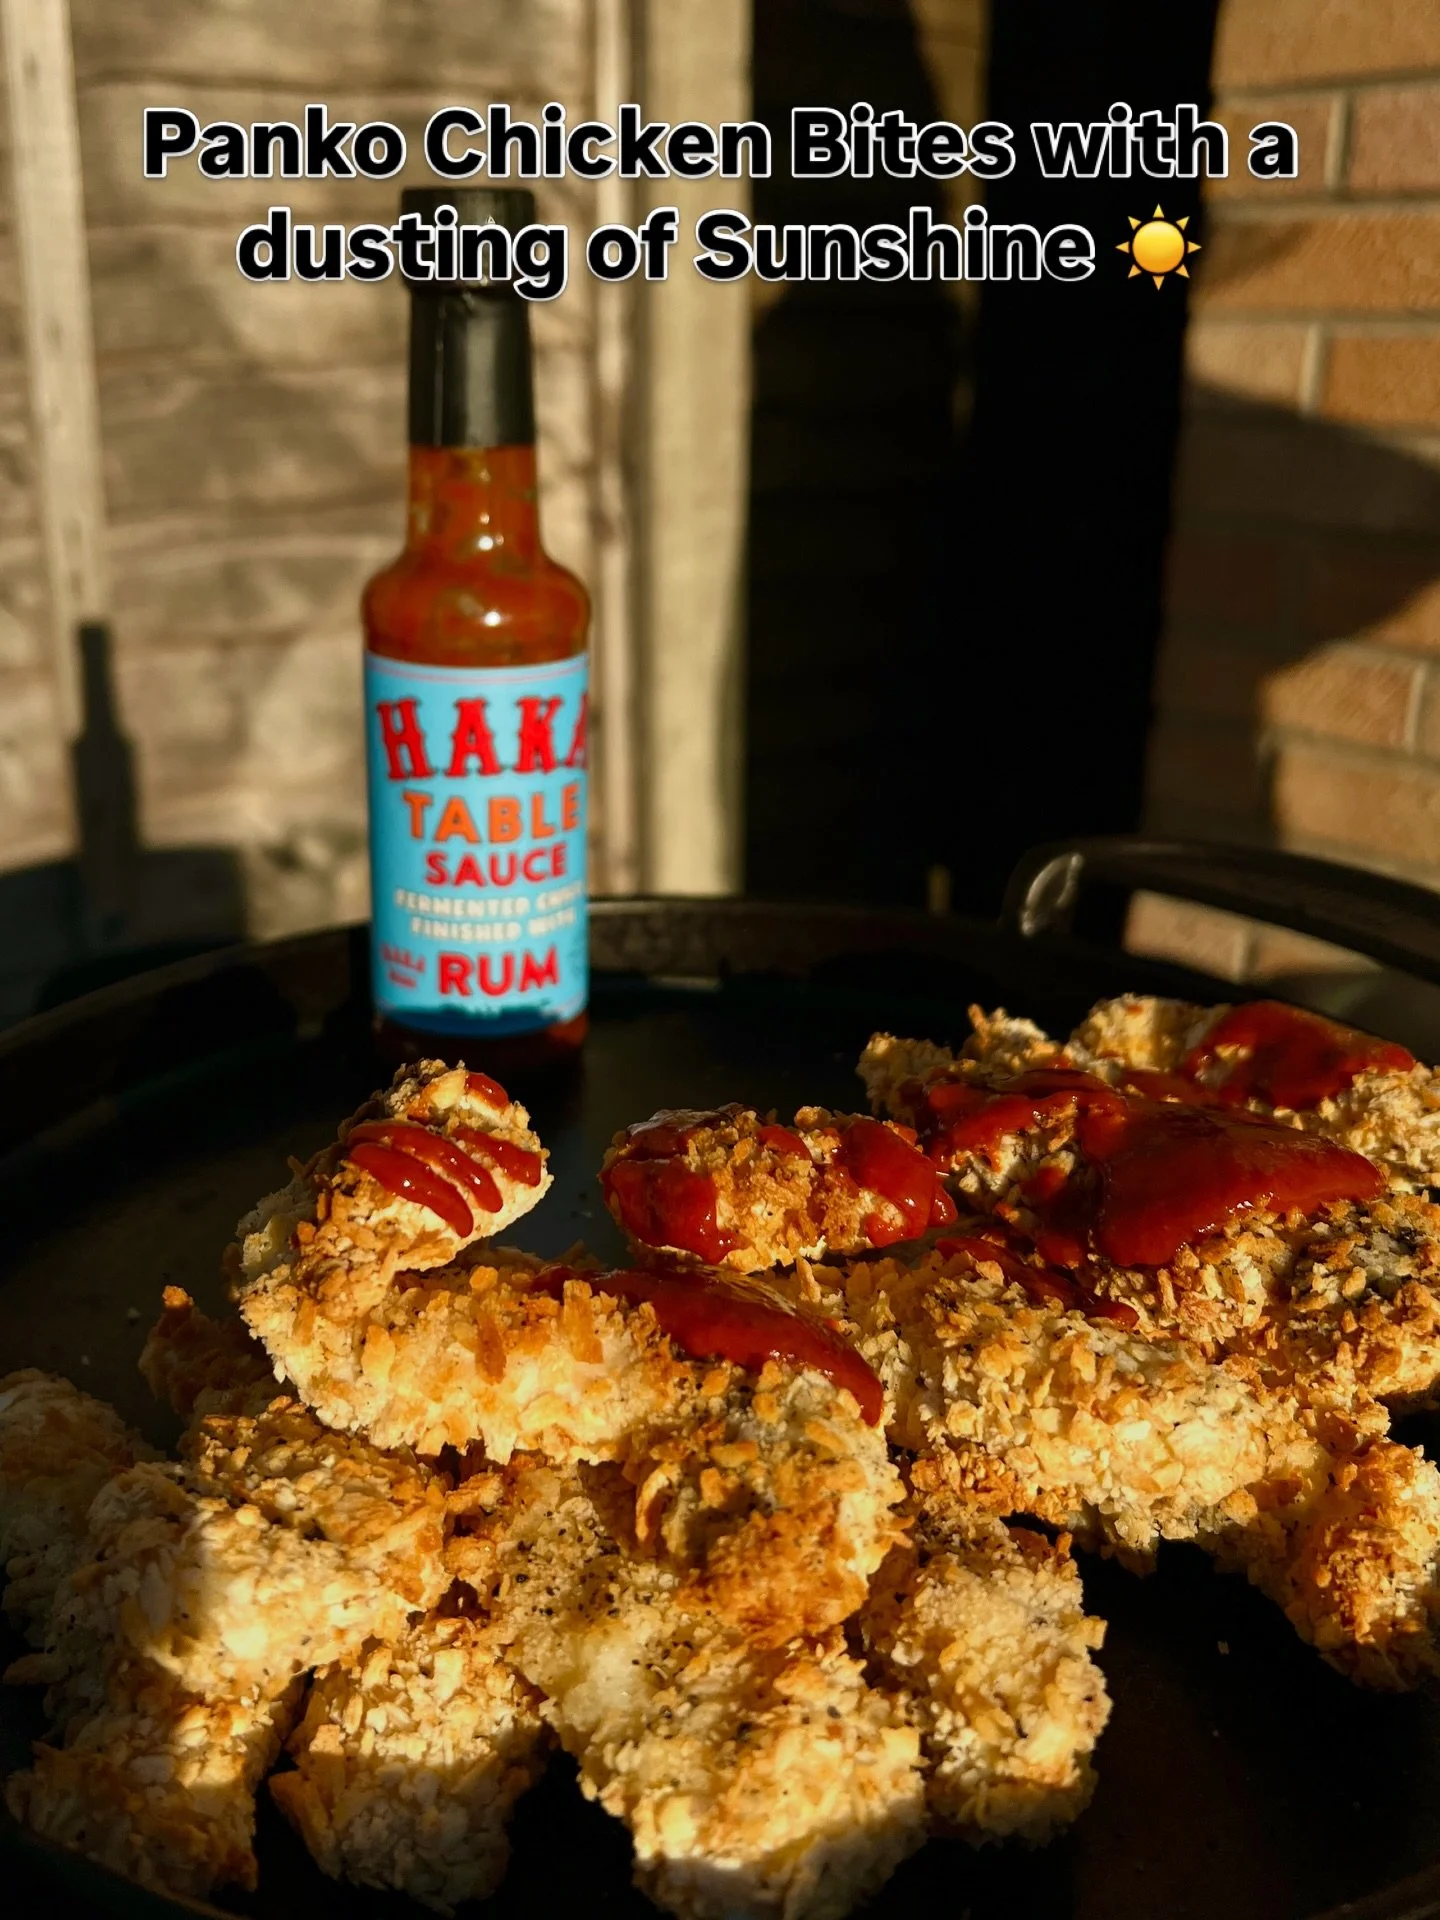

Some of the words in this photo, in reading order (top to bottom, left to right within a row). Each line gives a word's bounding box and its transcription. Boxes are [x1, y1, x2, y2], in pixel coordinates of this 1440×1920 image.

[402, 781, 582, 844] TABLE
[425, 842, 568, 888] SAUCE
[395, 888, 530, 918] FERMENTED
[411, 916, 522, 942] FINISHED
[437, 944, 560, 997] RUM
